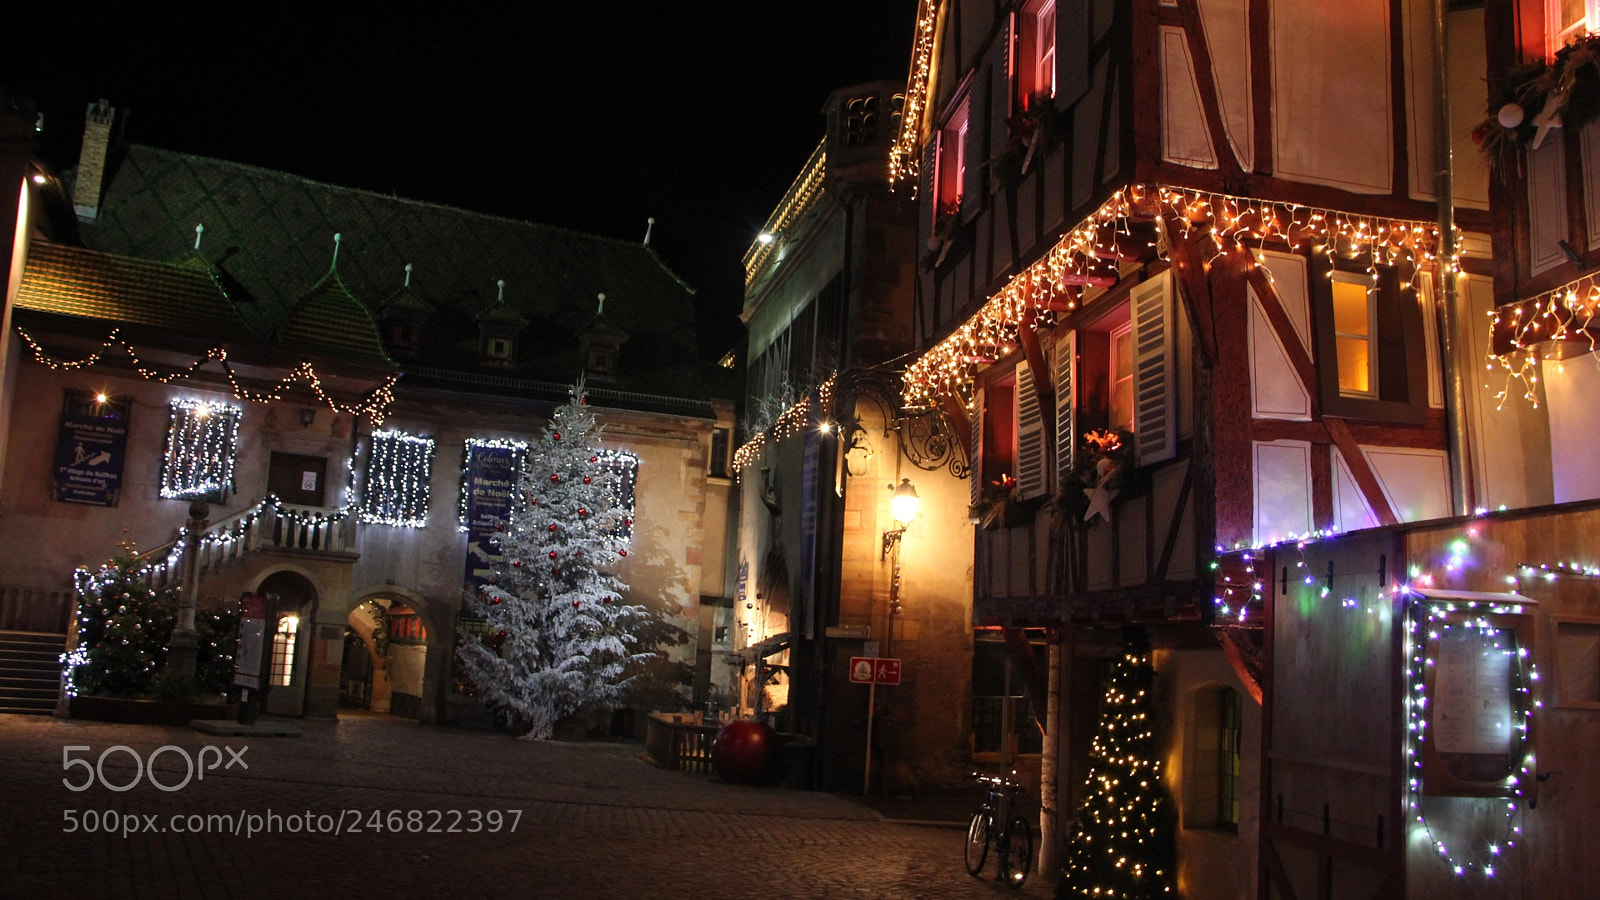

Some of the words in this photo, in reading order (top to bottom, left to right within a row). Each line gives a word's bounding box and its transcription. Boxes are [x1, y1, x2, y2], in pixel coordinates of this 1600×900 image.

[64, 420, 94, 430] Marché
[477, 450, 510, 464] Colmar
[474, 476, 510, 488] Marché
[473, 487, 485, 496] de
[487, 488, 510, 498] Noël
